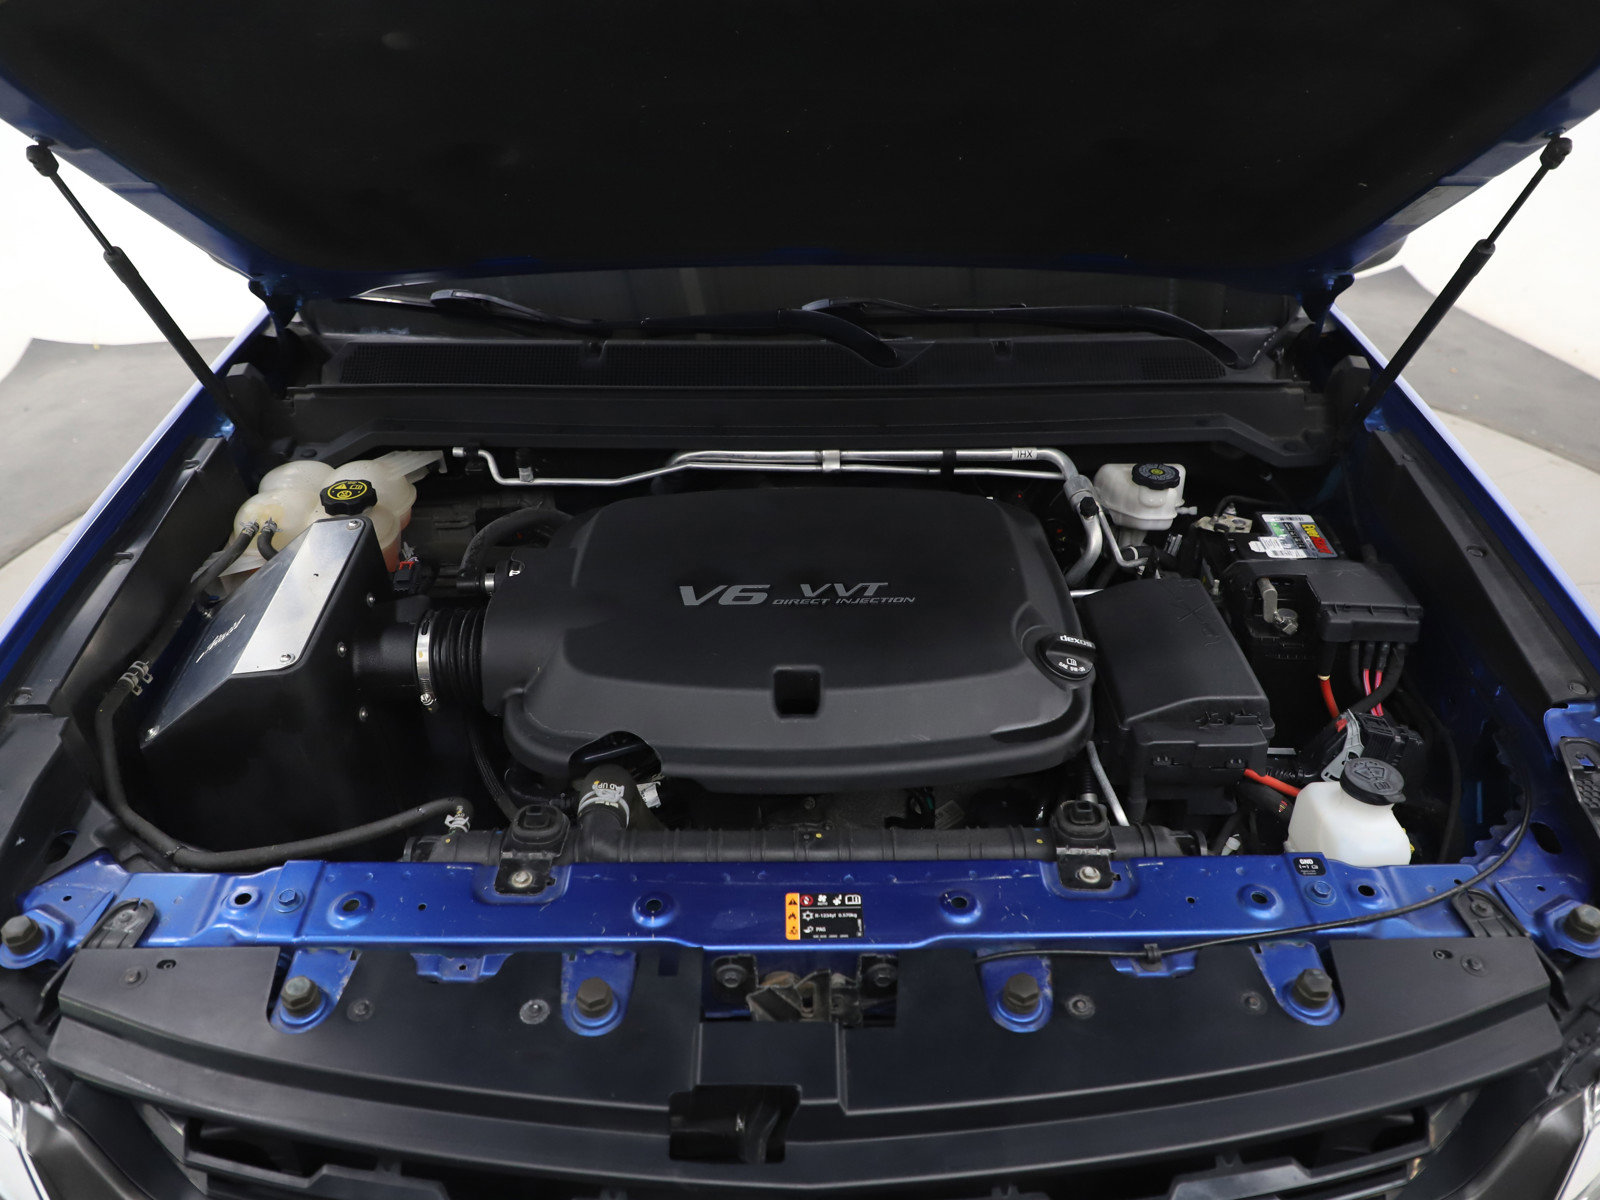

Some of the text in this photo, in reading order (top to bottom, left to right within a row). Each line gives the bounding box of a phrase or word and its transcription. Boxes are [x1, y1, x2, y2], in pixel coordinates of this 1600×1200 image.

[678, 584, 771, 606] V6
[799, 582, 889, 598] VVT
[835, 596, 916, 604] INJECTION
